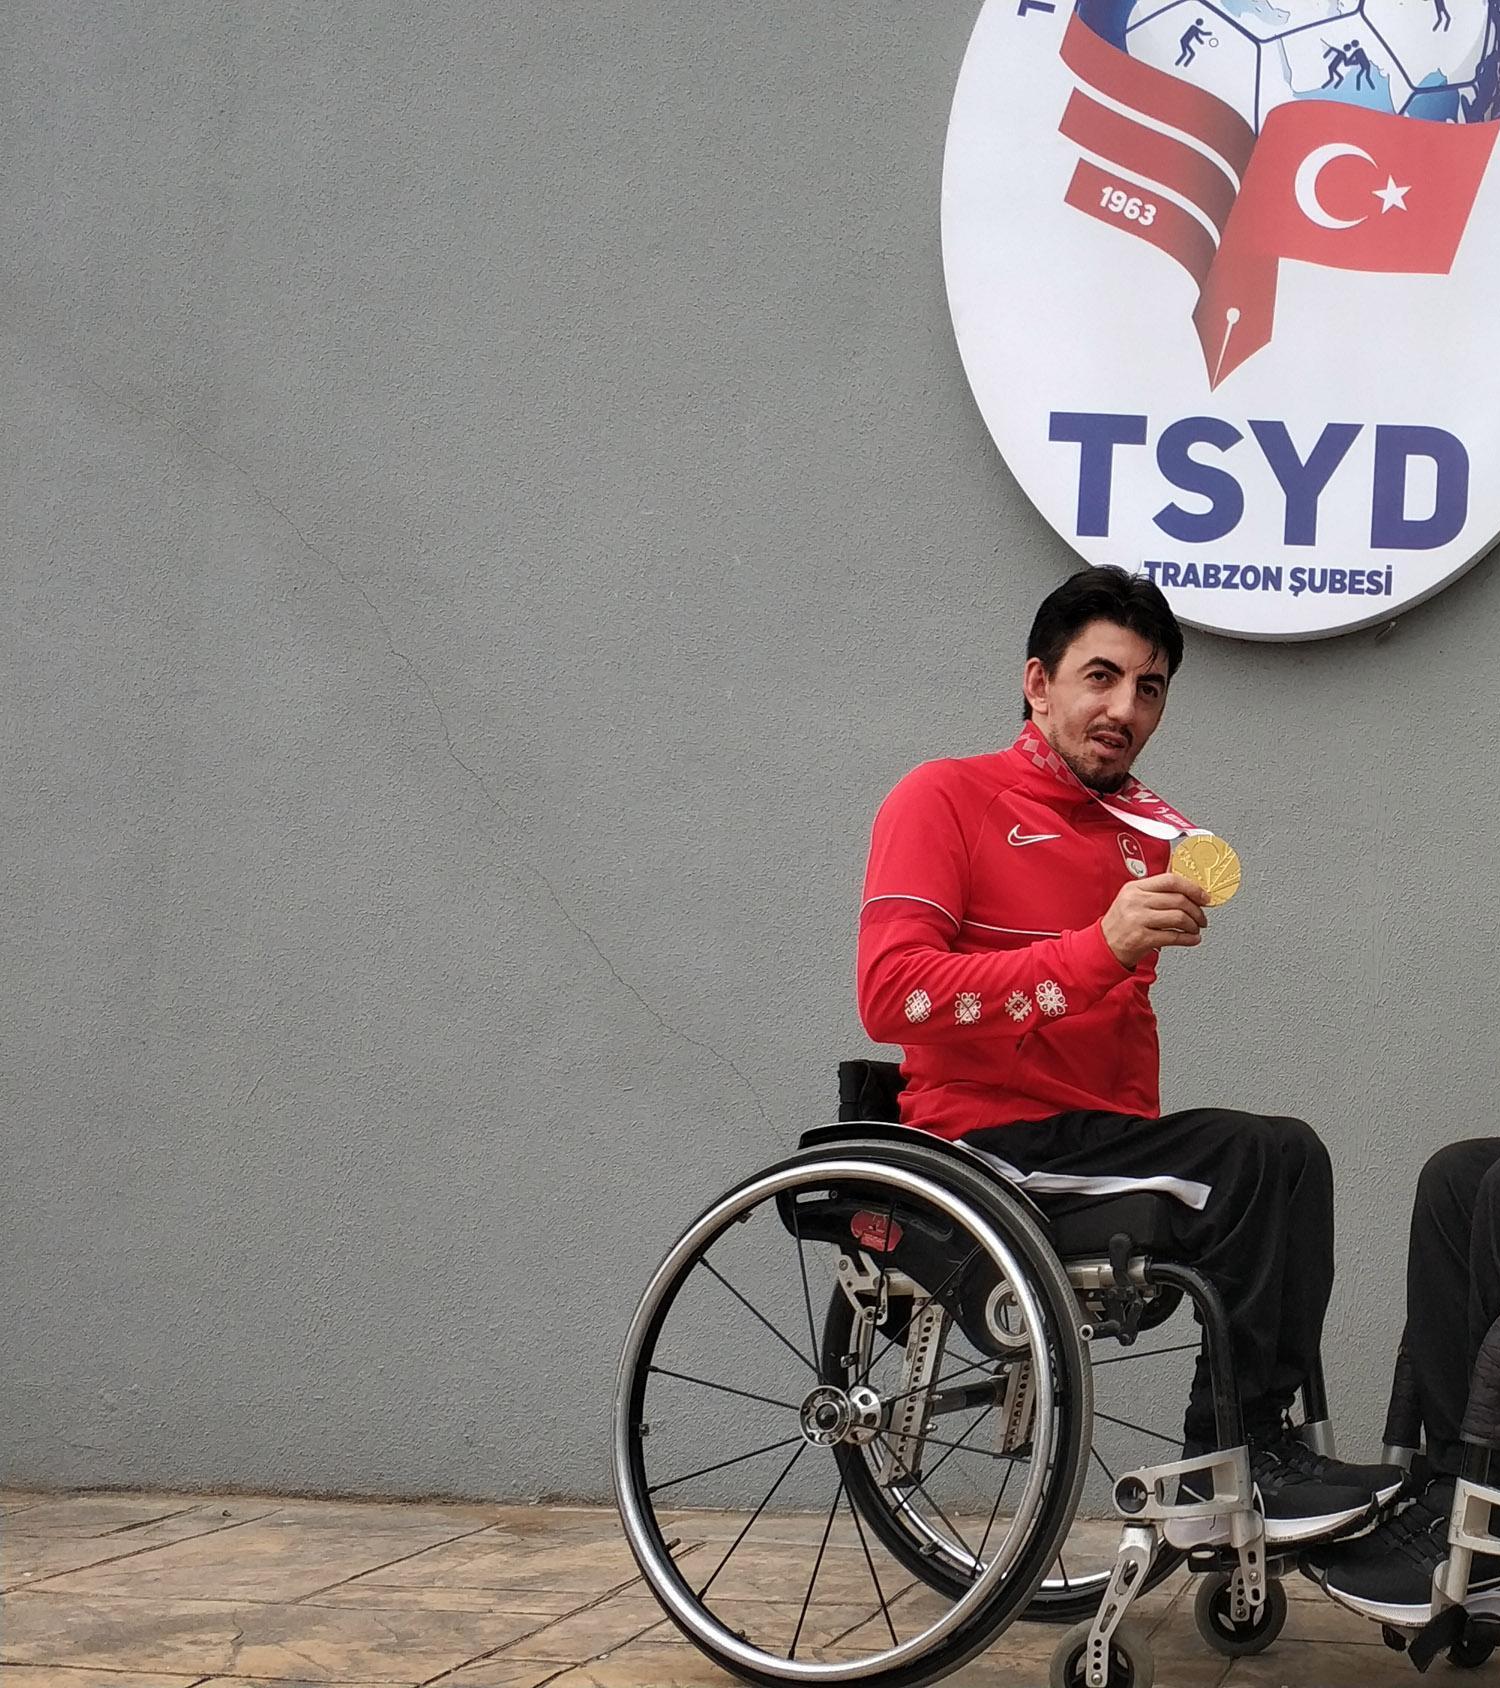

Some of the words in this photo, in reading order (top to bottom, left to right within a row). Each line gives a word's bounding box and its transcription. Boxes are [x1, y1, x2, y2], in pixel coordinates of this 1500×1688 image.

[1100, 186, 1157, 226] 1963
[1048, 411, 1470, 551] TSYD
[1144, 560, 1282, 591] TRABZON
[1288, 564, 1393, 597] ŞUBESİ
